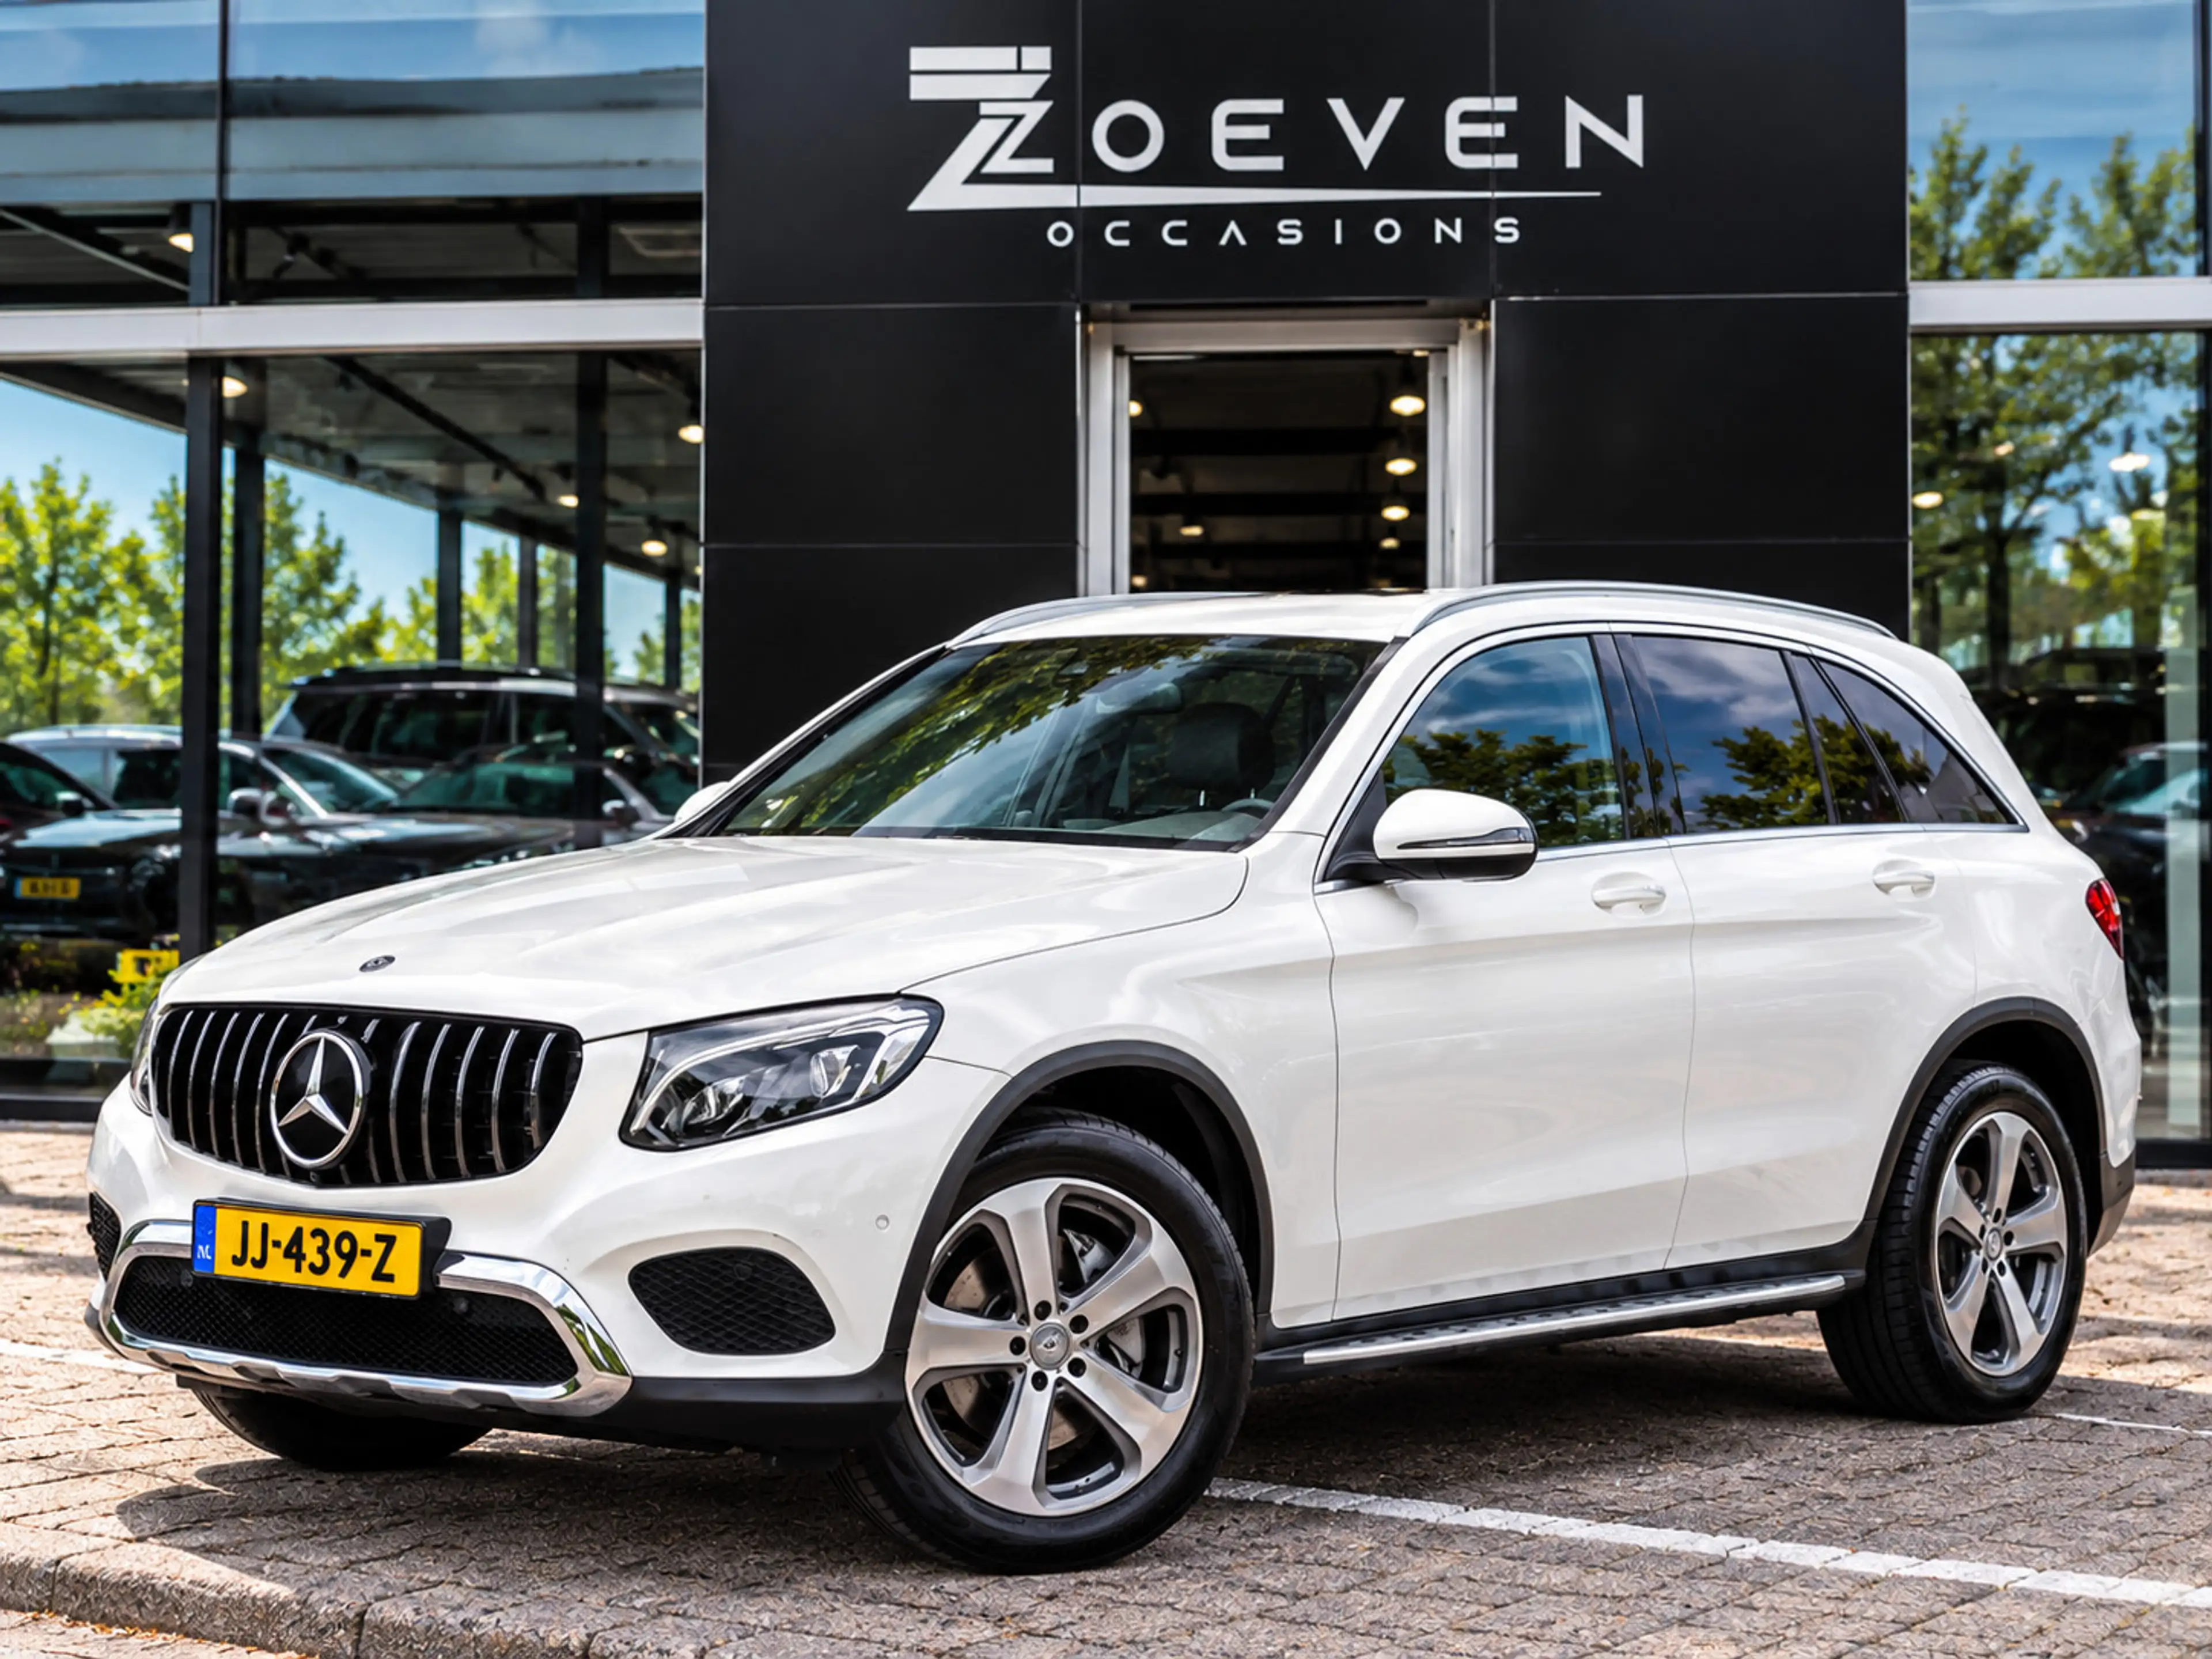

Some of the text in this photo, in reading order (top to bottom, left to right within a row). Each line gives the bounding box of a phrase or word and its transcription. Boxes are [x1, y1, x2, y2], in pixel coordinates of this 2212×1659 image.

[907, 47, 1644, 211] ZOEVEN
[1047, 217, 1520, 247] OCCASIONS
[232, 1221, 397, 1283] JJ-439-Z
